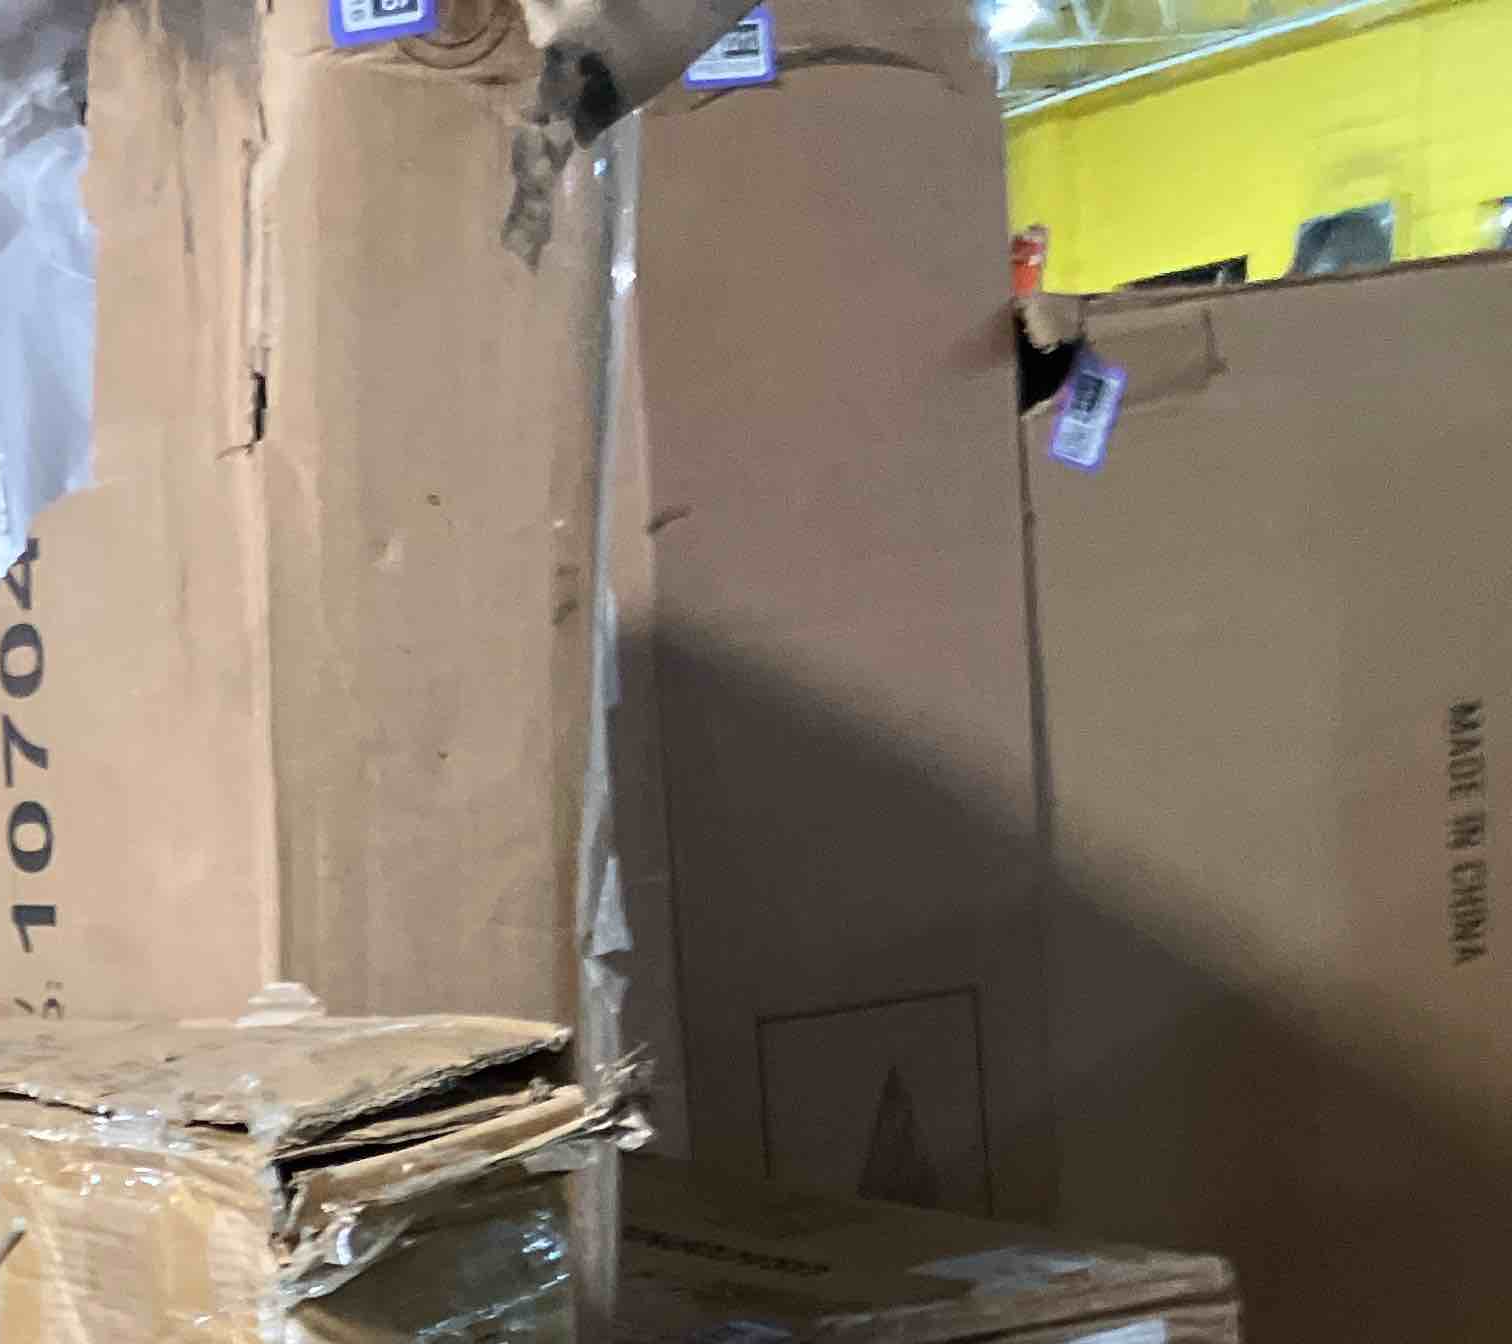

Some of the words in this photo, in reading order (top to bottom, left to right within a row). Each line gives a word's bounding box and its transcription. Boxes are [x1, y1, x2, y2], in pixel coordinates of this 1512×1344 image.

[1449, 701, 1486, 801] MADE
[1448, 814, 1485, 850] IN
[1449, 861, 1489, 966] CHINA
